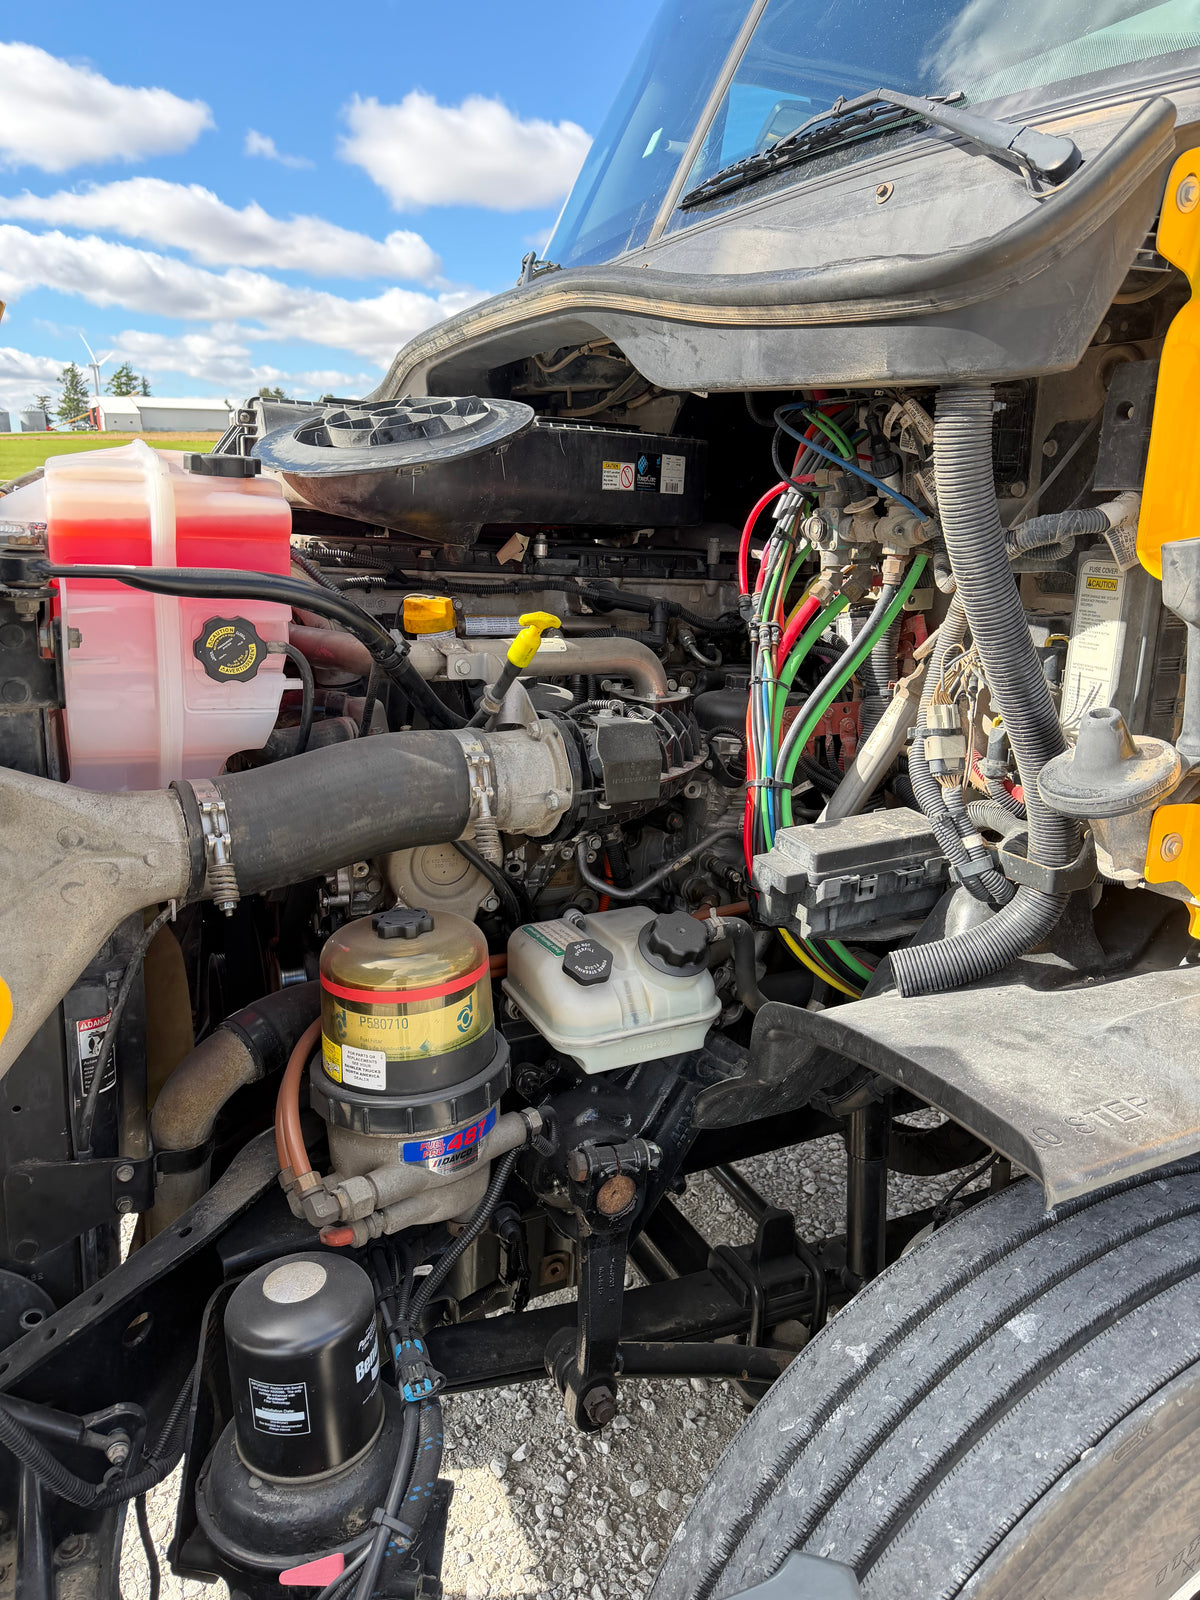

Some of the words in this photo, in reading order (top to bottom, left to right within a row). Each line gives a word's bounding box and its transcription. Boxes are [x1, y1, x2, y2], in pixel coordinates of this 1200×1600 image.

[1092, 580, 1116, 589] CAUTION
[209, 628, 234, 644] CAUTION
[225, 646, 255, 673] AVERTISSEMENT
[574, 947, 594, 957] OVERFILL
[574, 965, 597, 975] STEERING
[359, 1016, 409, 1030] P580710
[347, 1055, 377, 1064] REPLACEMENTS
[1063, 1096, 1149, 1135] STEP
[447, 1118, 486, 1151] 487
[420, 1139, 445, 1151] FUEL
[422, 1148, 445, 1159] PRO
[441, 1147, 473, 1165] DAVCO
